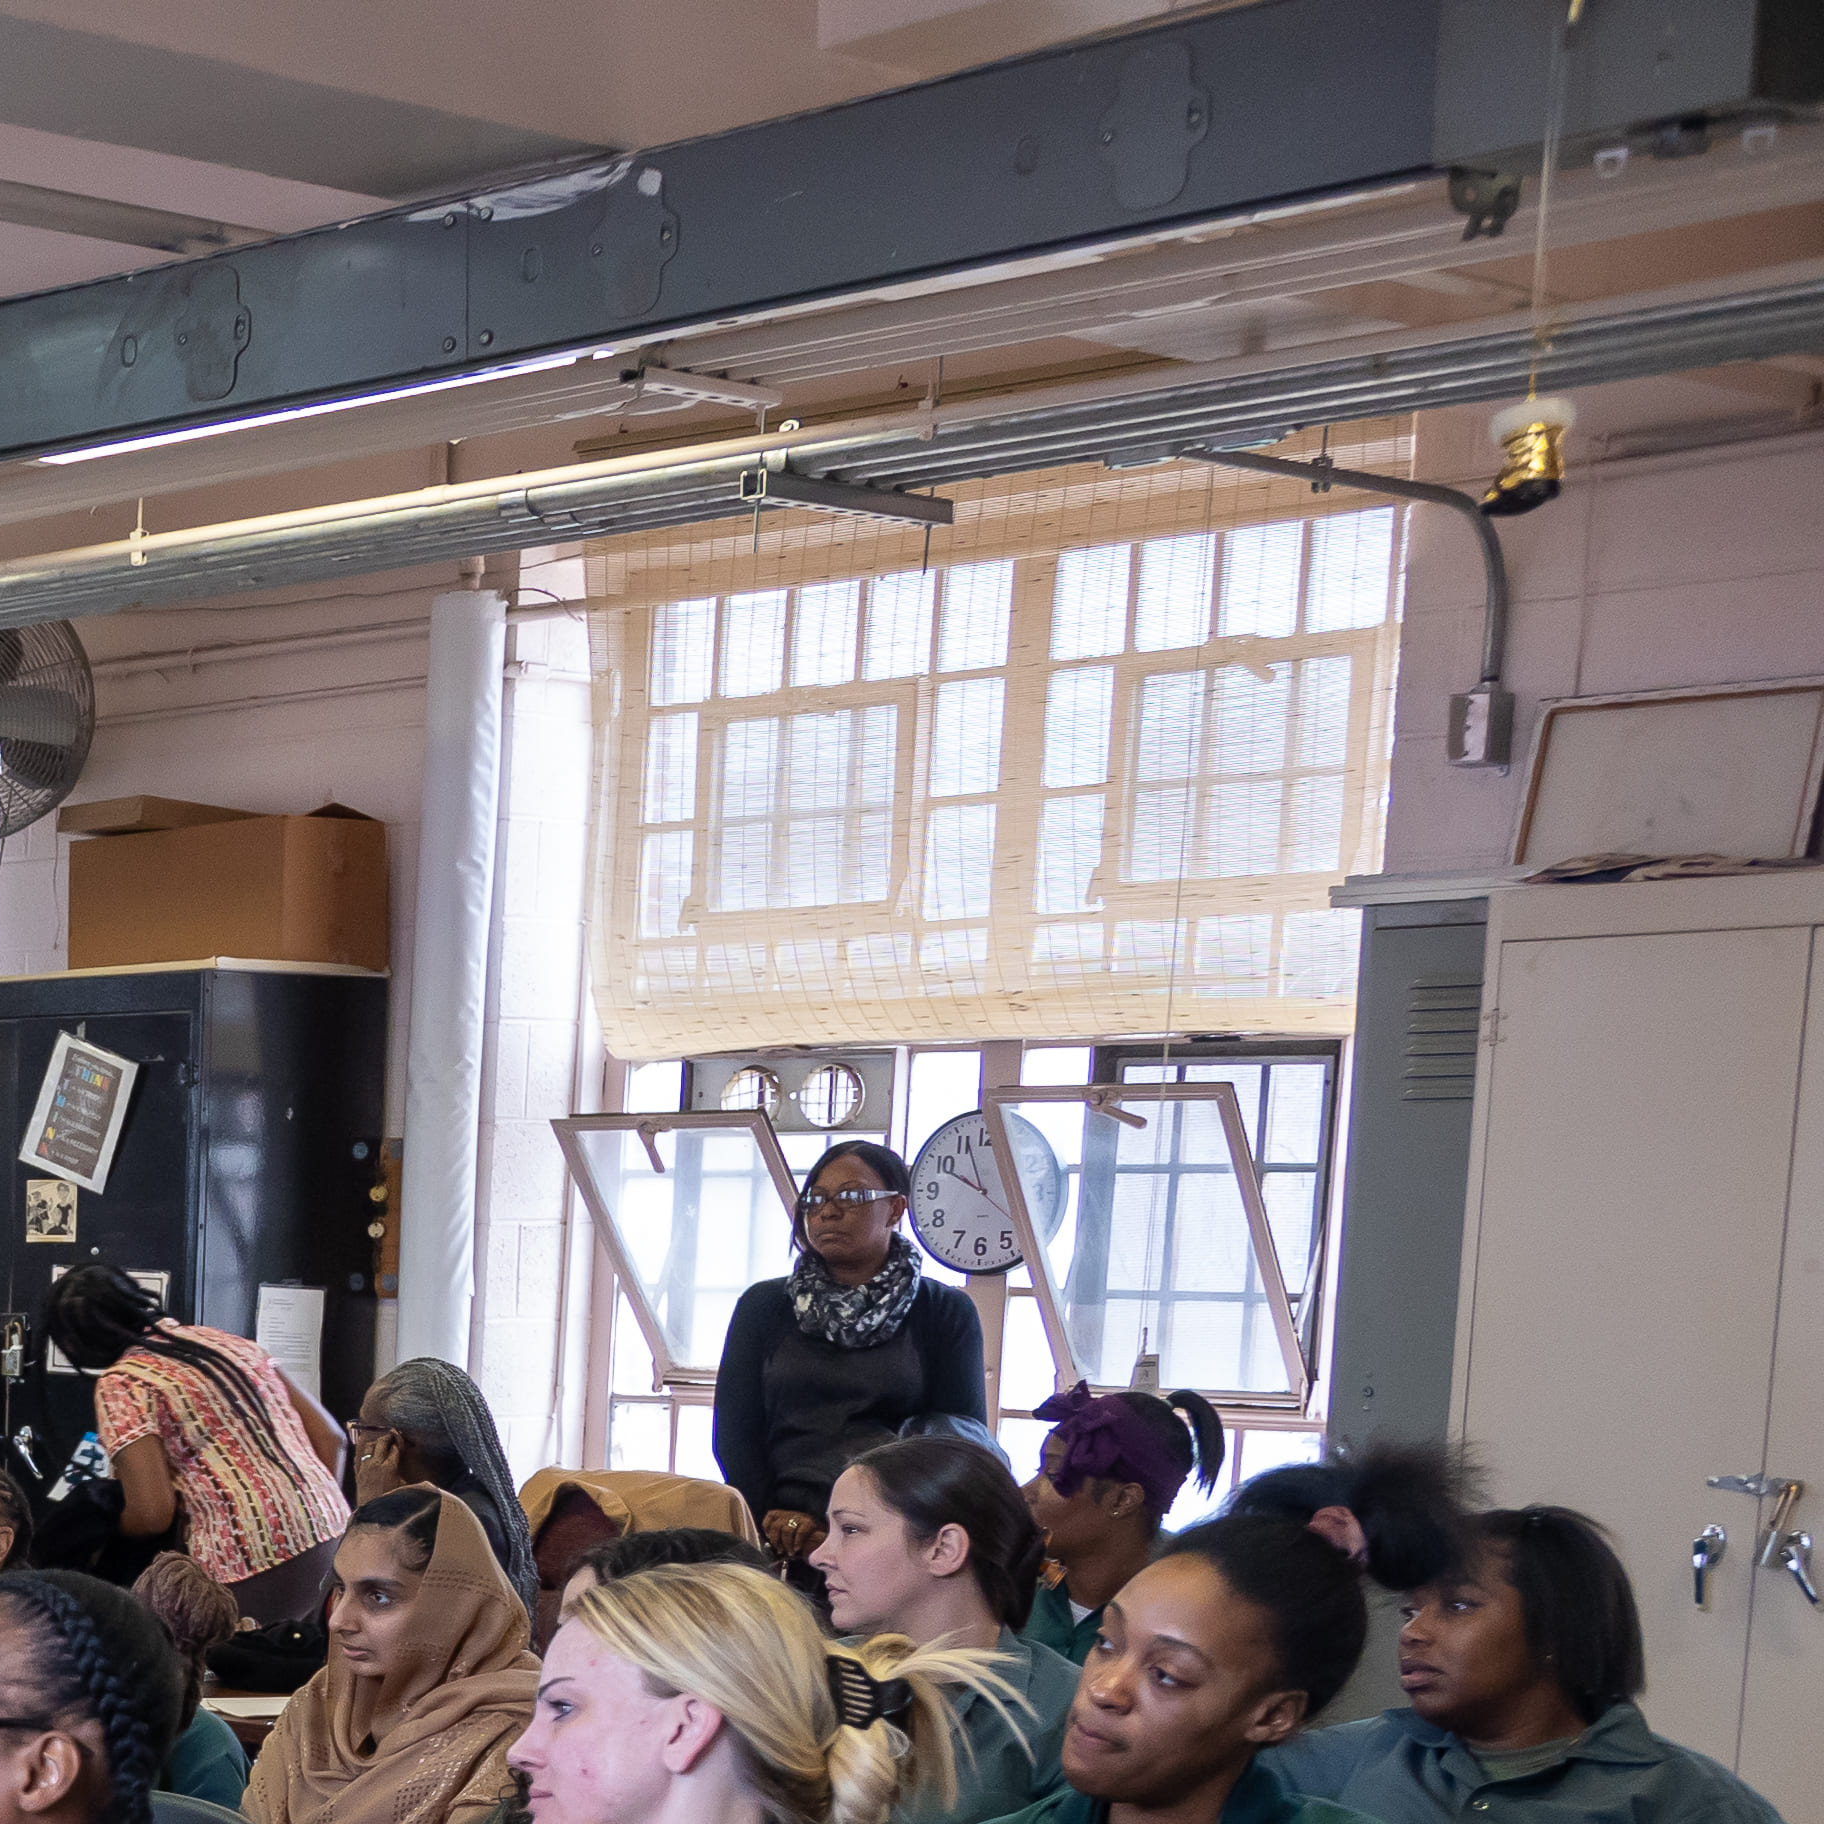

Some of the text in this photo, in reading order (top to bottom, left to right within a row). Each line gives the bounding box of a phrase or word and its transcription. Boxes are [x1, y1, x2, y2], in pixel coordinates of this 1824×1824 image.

[957, 1135, 970, 1154] 11
[936, 1155, 955, 1174] 10
[926, 1182, 939, 1200] 9
[932, 1209, 945, 1228] 8
[952, 1230, 966, 1248] 7
[974, 1237, 987, 1256] 6
[1000, 1231, 1012, 1250] 5
